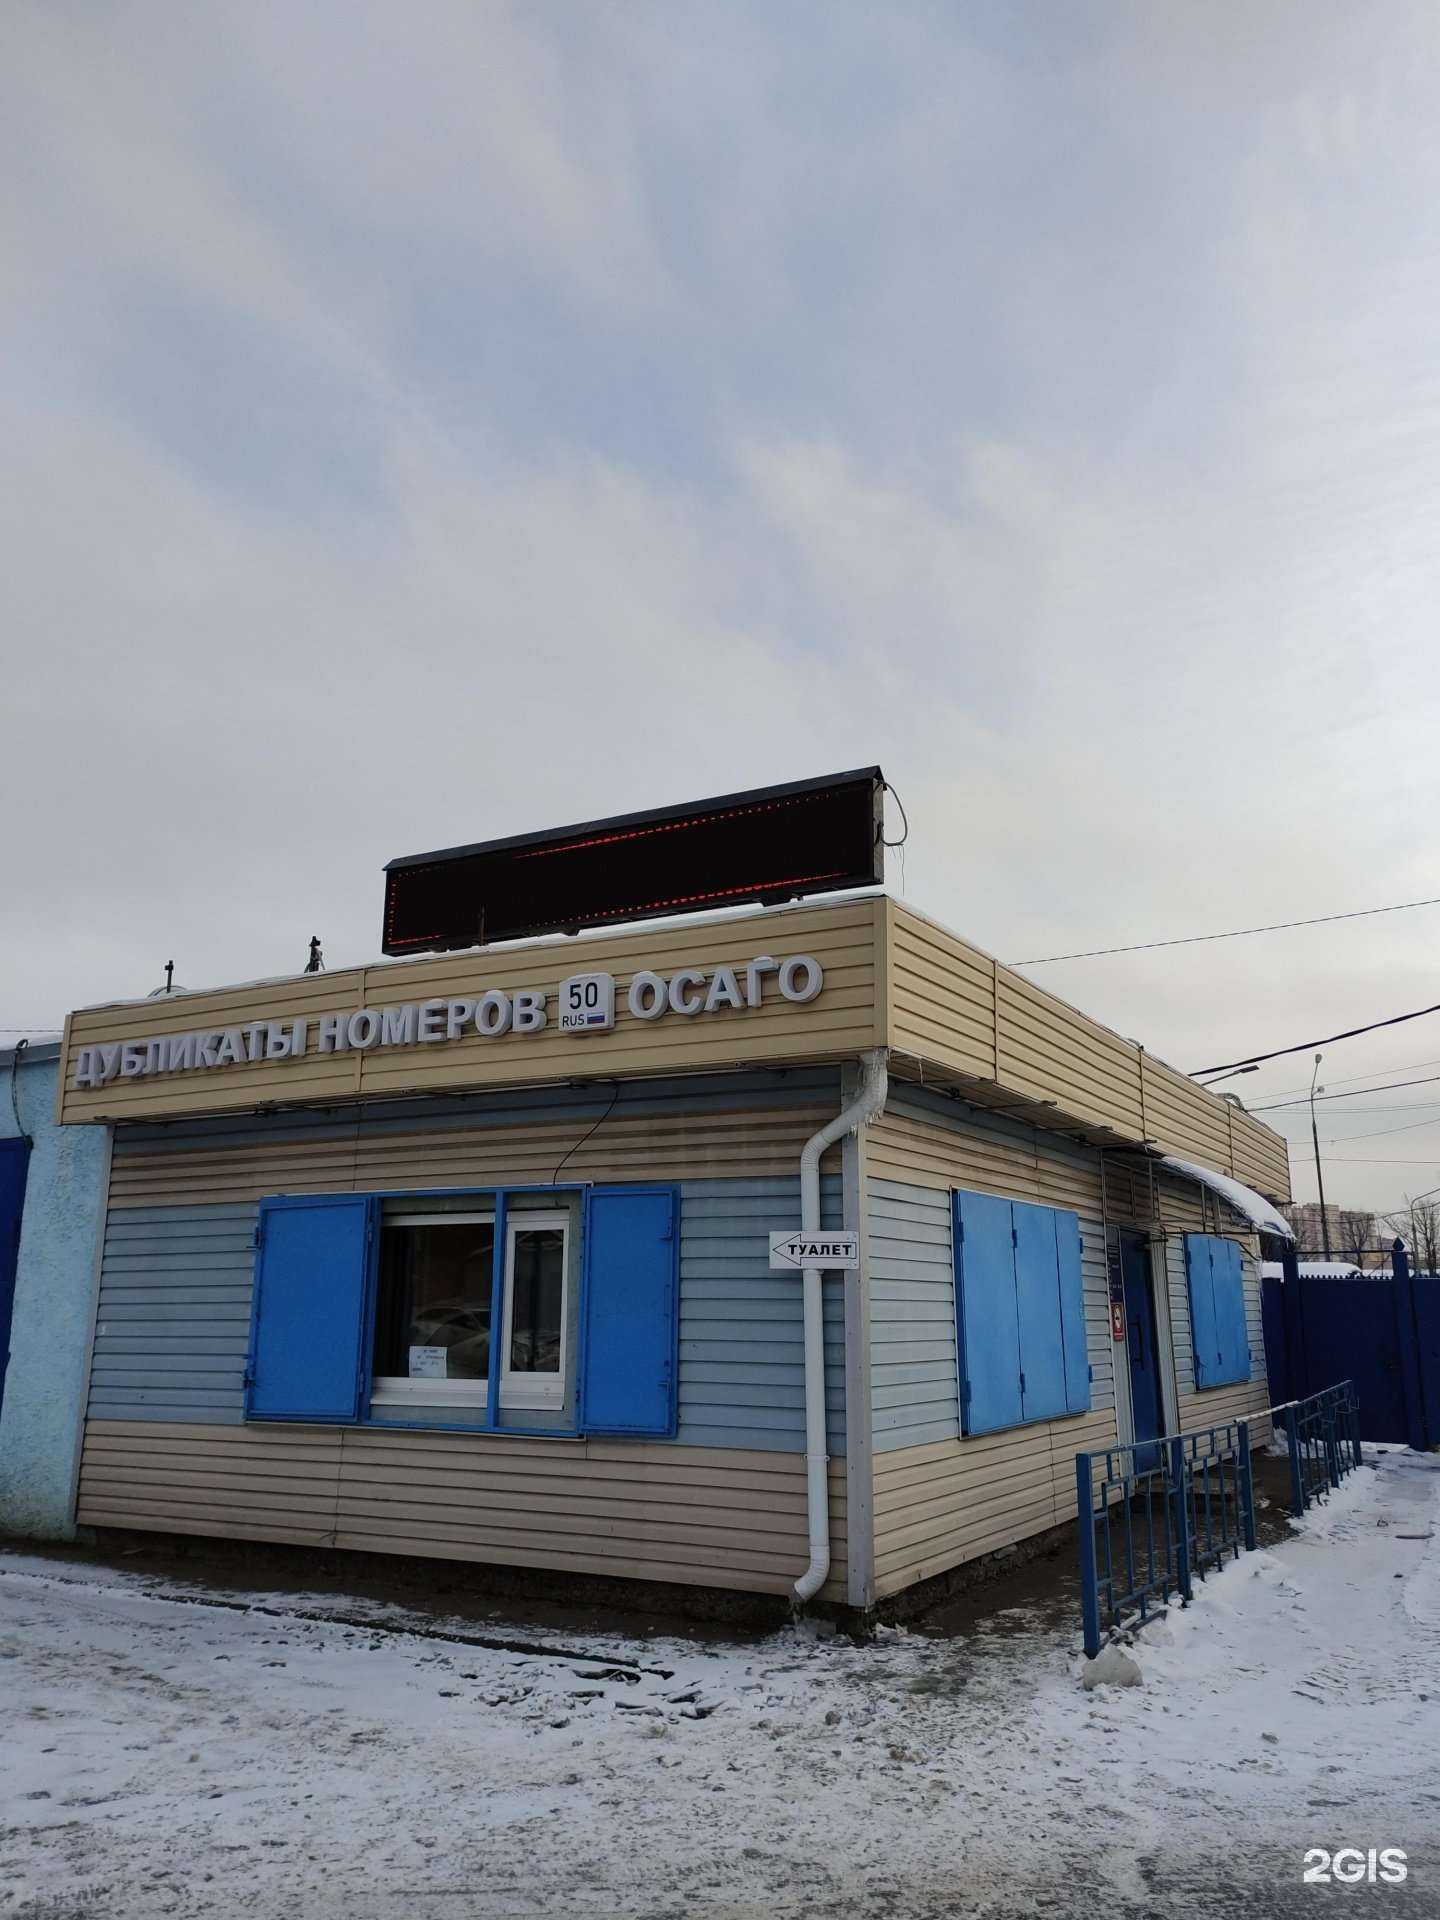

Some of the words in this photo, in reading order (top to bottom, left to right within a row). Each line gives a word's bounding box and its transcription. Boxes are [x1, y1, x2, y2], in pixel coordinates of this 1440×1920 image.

[569, 982, 598, 1009] 50
[628, 956, 824, 1019] ОСАГО
[562, 1014, 585, 1028] RUS
[76, 1021, 306, 1087] ДУБЛИКАТЫ
[318, 990, 546, 1052] НОМЕРОВ
[788, 1244, 852, 1256] ТУАЛЕТ
